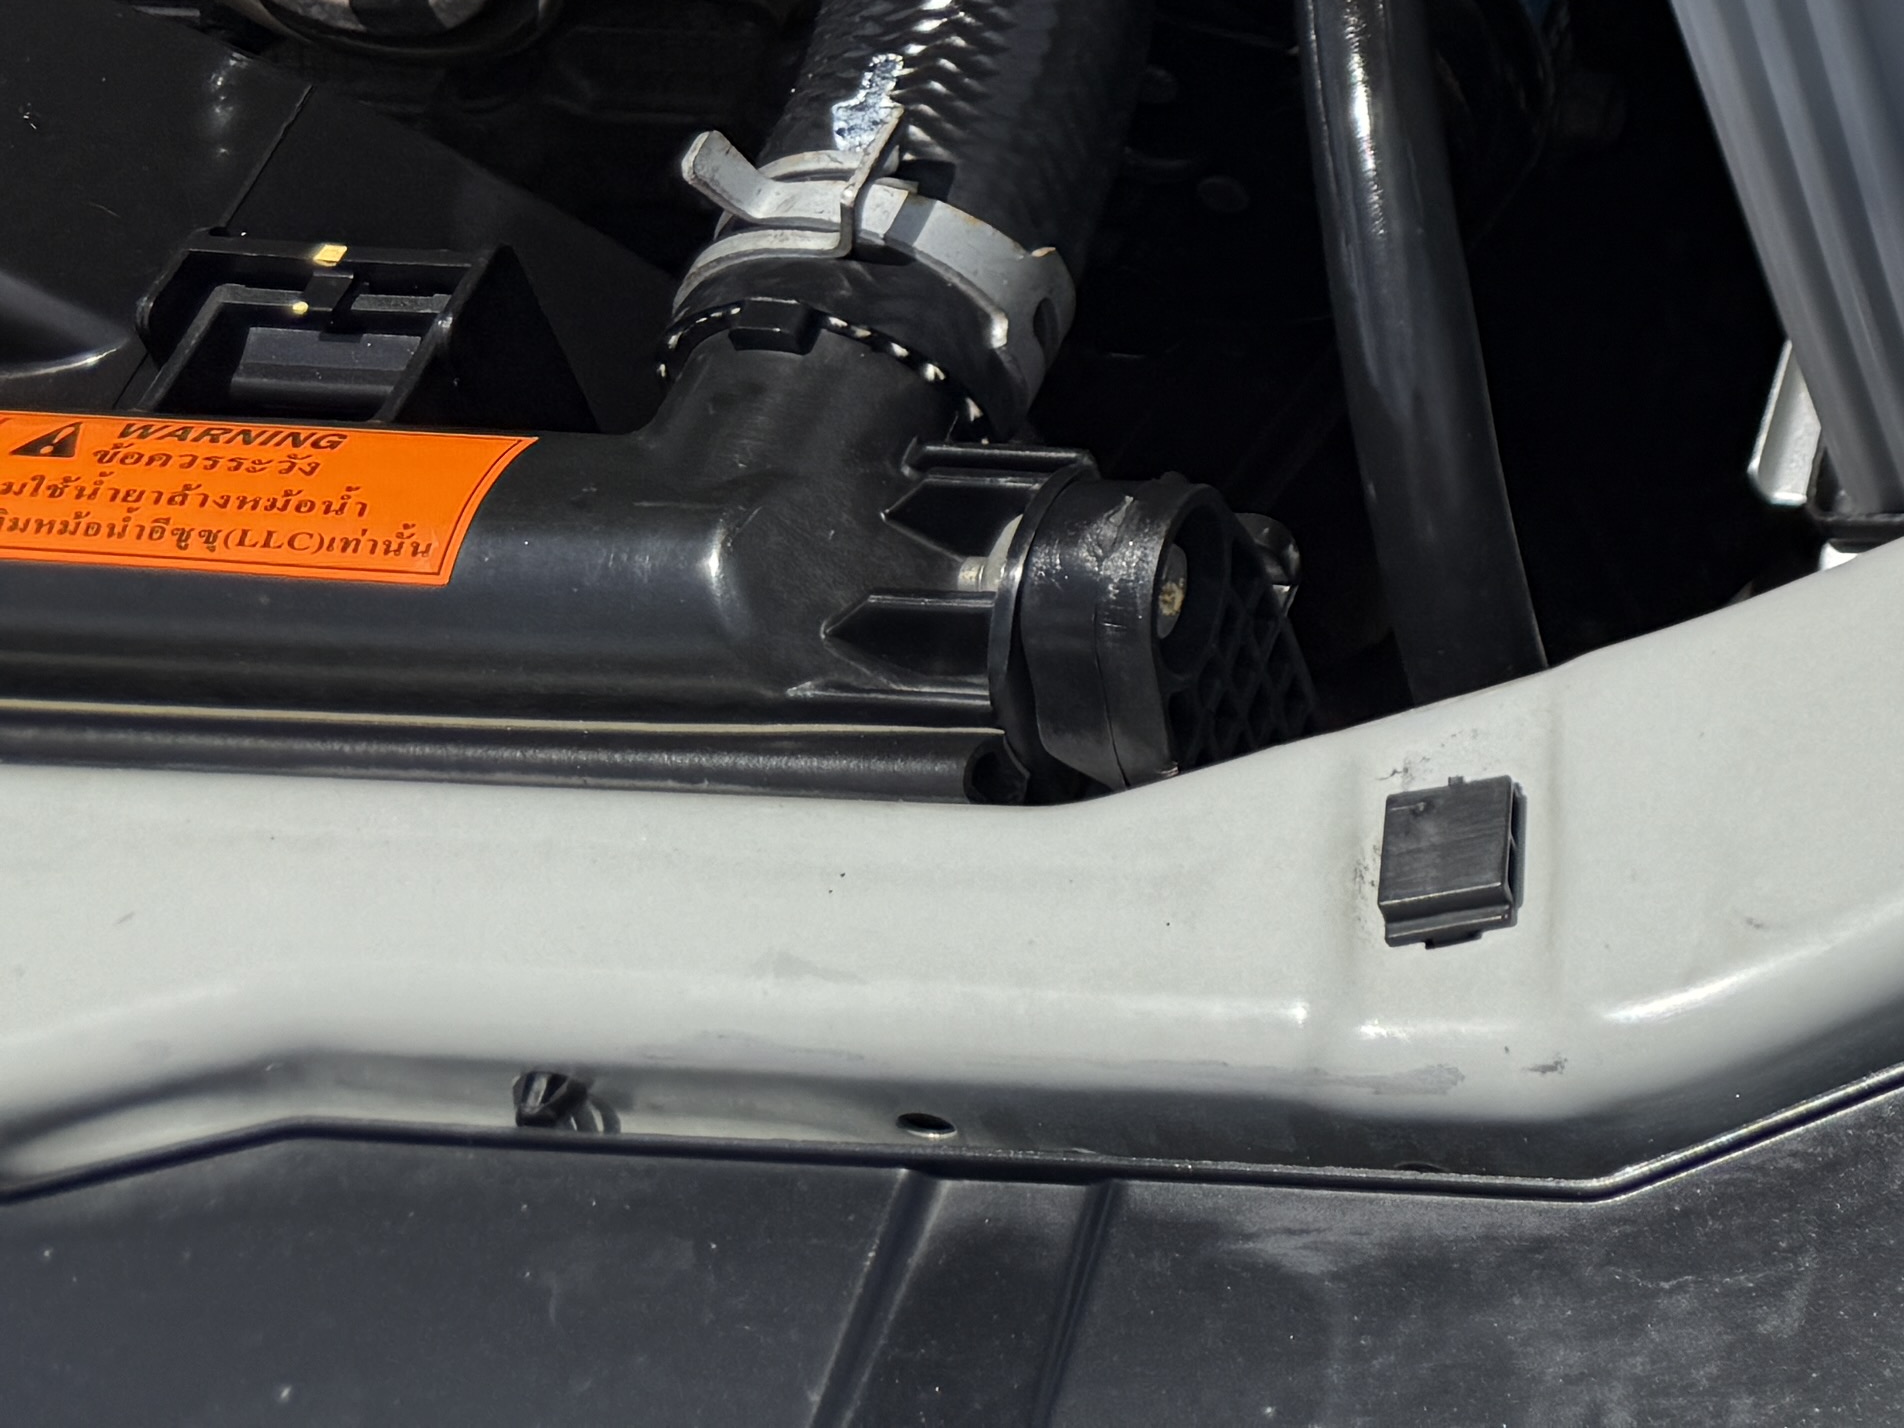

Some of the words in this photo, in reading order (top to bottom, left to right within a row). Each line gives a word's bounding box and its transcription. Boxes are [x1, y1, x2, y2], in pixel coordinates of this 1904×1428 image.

[116, 422, 349, 452] WARNING
[92, 443, 322, 478] ข้อควรระวัง
